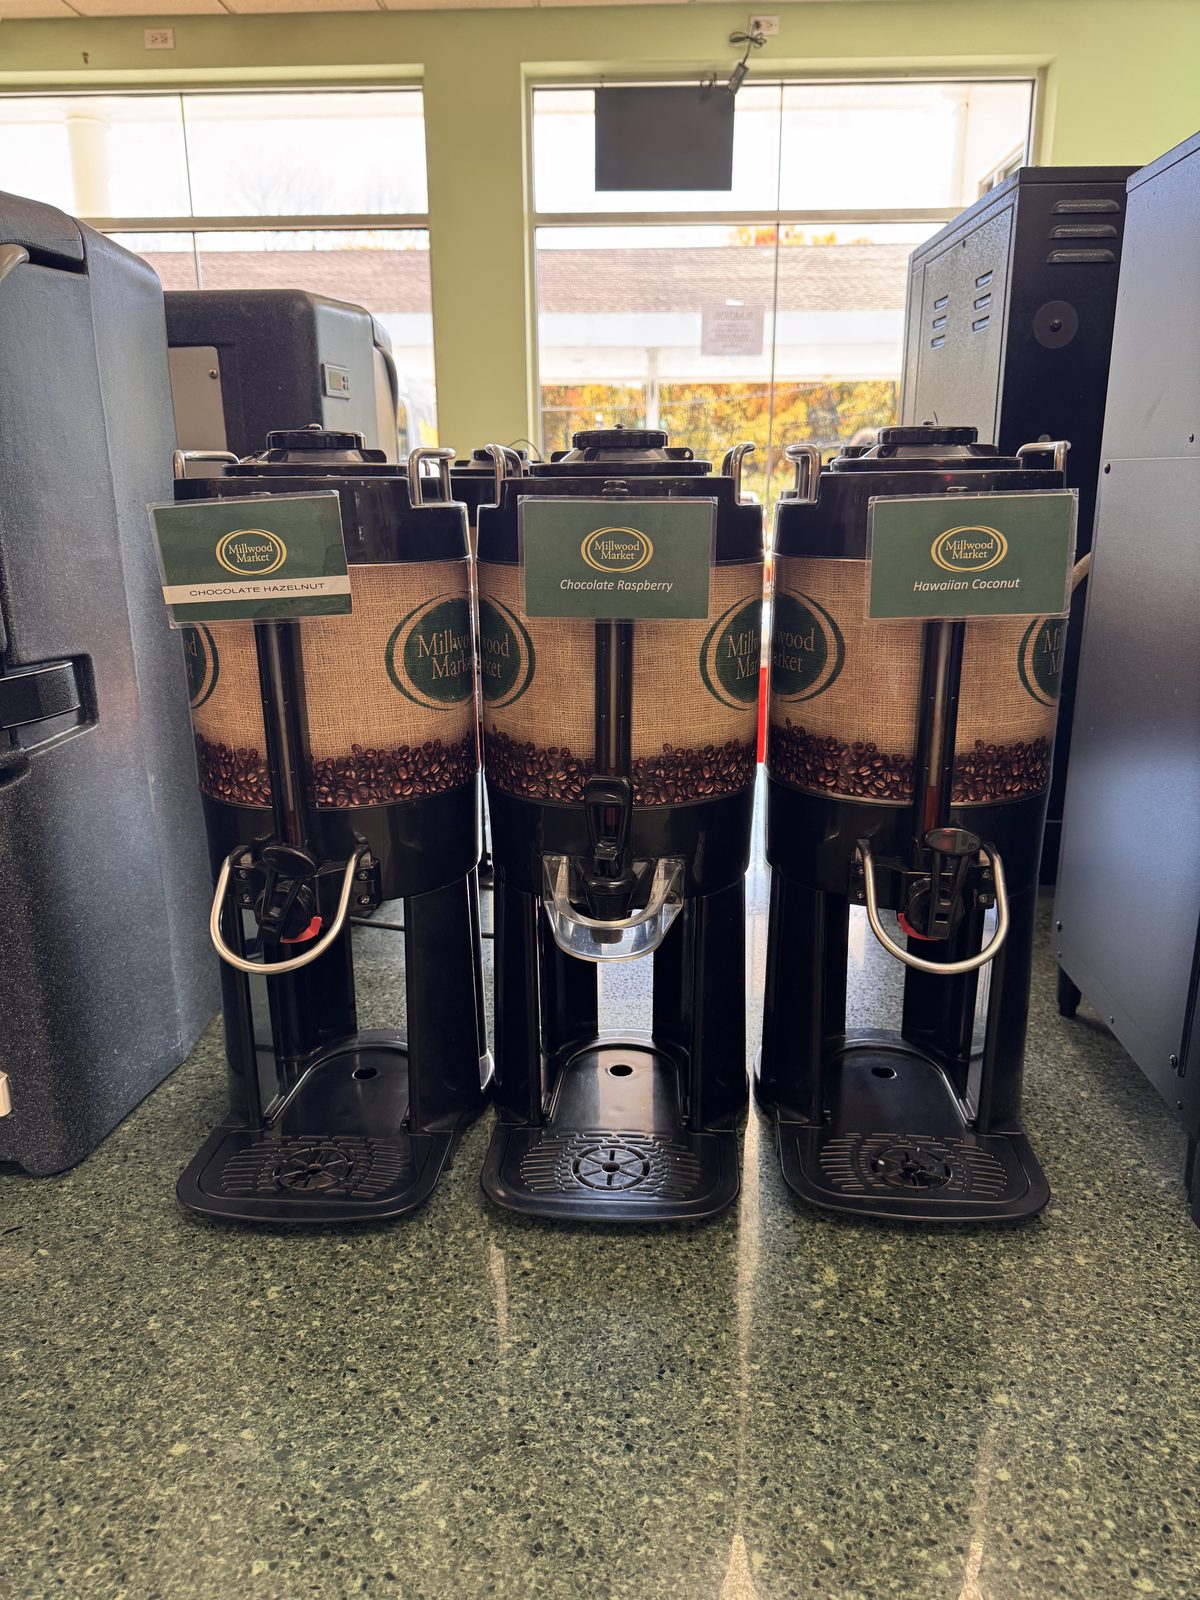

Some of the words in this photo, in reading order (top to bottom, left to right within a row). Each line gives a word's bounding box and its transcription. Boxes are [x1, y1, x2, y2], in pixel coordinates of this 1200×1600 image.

[228, 541, 273, 555] Millwood
[594, 540, 640, 551] Millwood
[945, 539, 994, 551] Millwood
[236, 552, 270, 563] Market
[600, 549, 635, 560] Market
[951, 548, 988, 560] Market
[189, 586, 260, 597] CHOCOLATE
[263, 582, 326, 593] HAZELNUT
[559, 579, 615, 590] Chocolate
[617, 580, 674, 593] Raspberry
[913, 580, 969, 592] Hawaiian
[971, 577, 1021, 590] Coconut
[417, 628, 469, 658] Millwo
[736, 654, 760, 680] Mar
